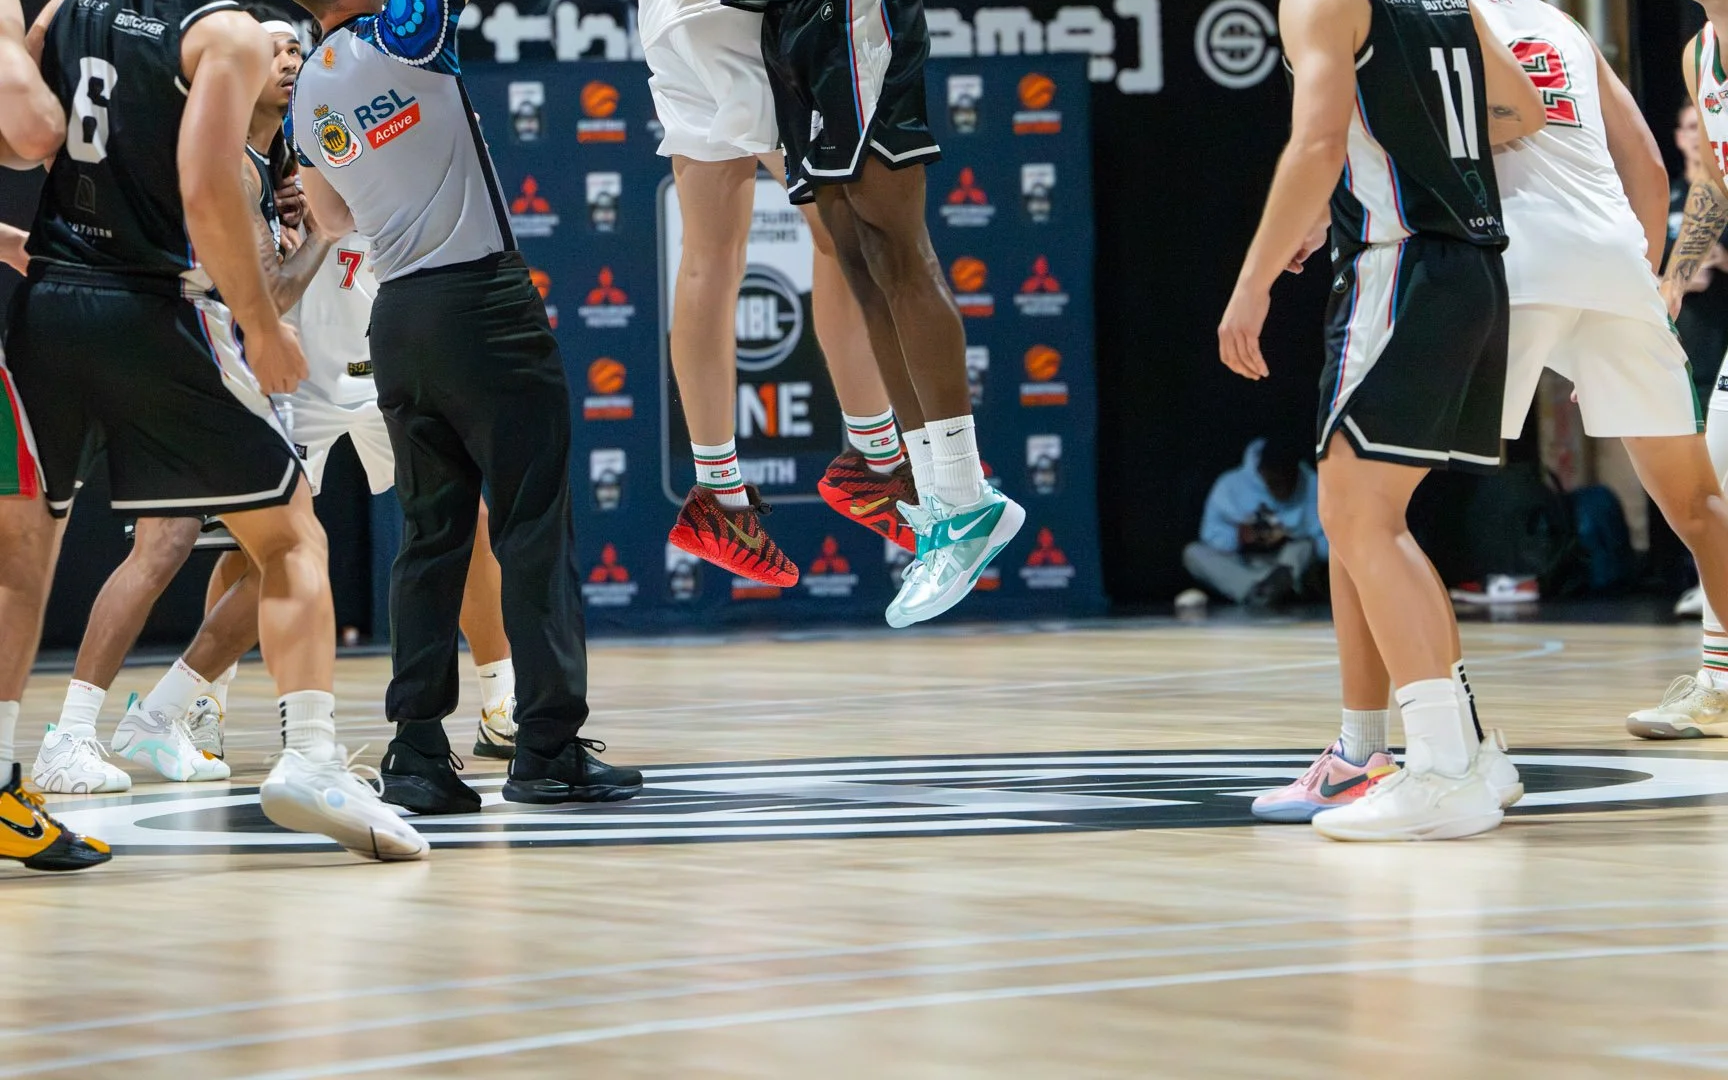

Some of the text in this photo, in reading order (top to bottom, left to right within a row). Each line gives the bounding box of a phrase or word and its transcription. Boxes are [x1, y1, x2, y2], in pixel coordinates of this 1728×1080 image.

[114, 12, 166, 36] BUTCHER
[67, 57, 118, 164] 6
[354, 88, 416, 131] RSL
[1430, 47, 1480, 160] 11
[375, 115, 414, 143] Active
[337, 248, 365, 290] 7
